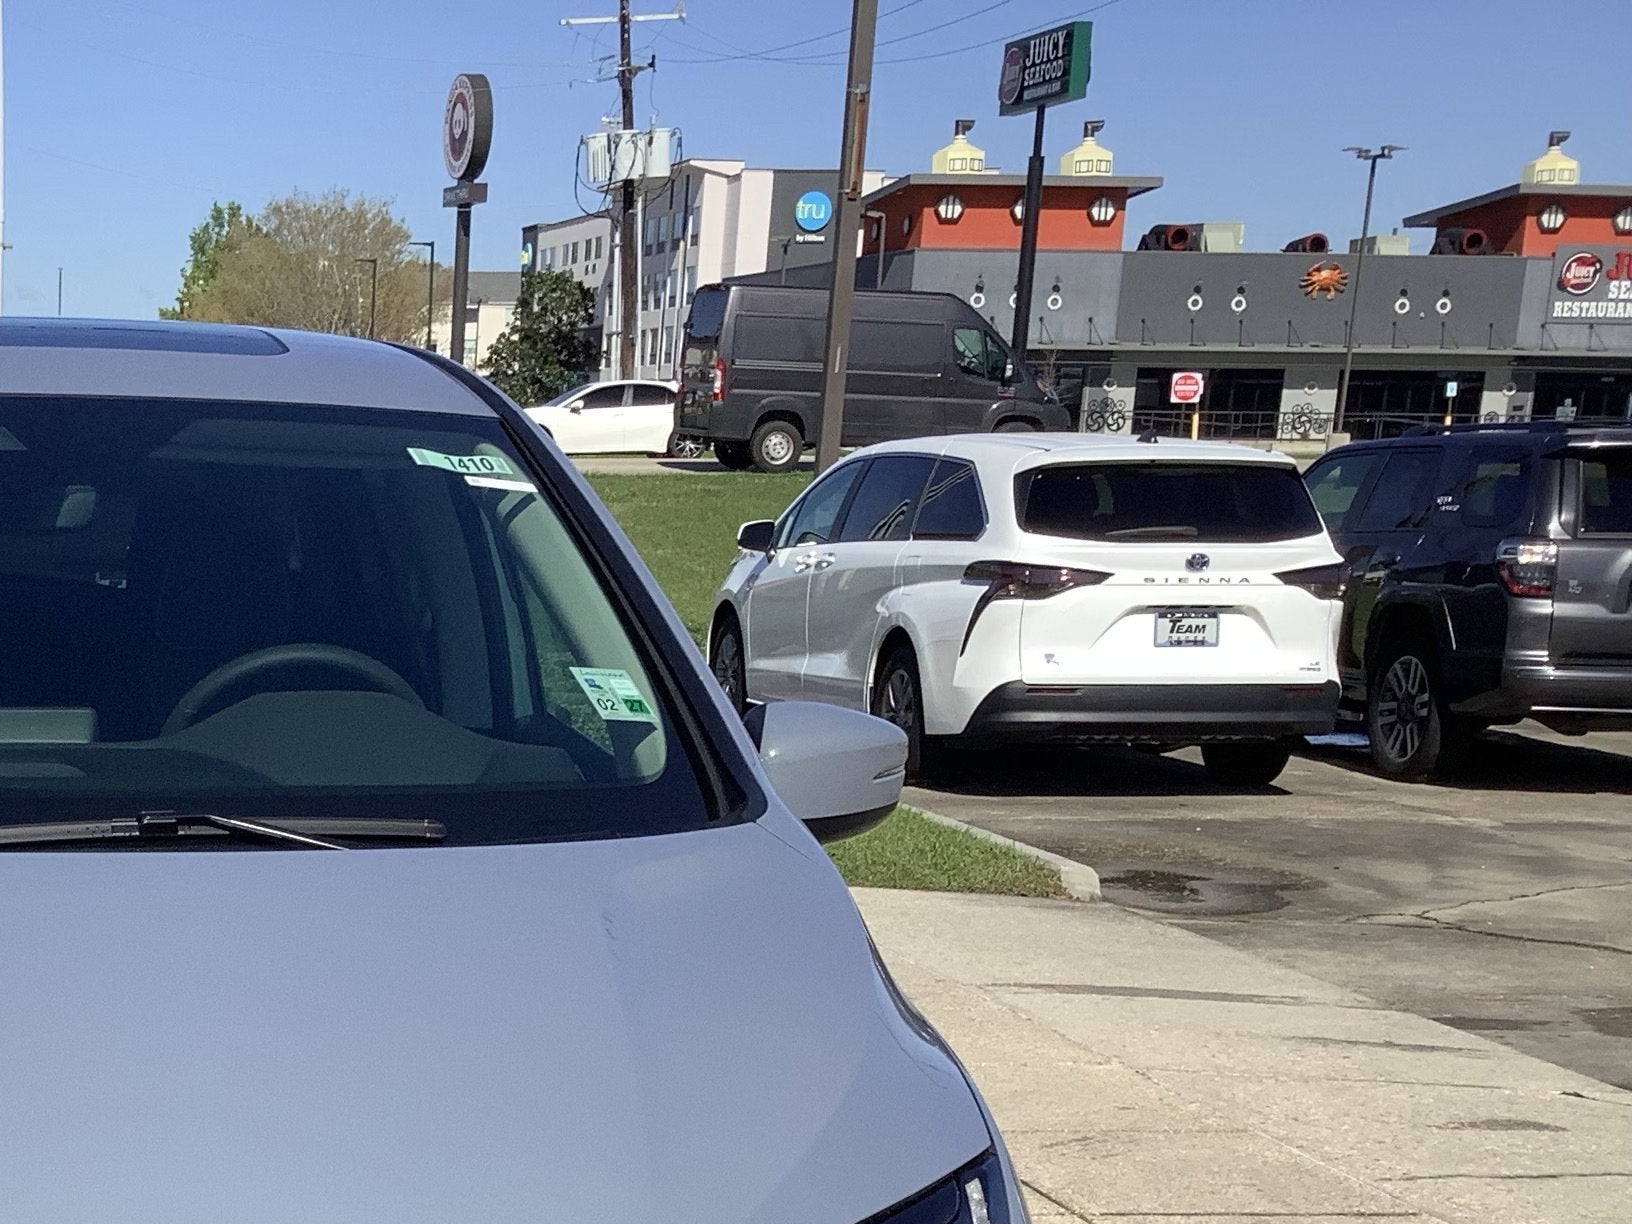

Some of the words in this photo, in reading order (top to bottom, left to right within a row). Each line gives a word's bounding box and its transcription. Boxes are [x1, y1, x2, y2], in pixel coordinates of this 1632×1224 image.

[1025, 30, 1067, 67] JUICY
[1024, 59, 1064, 87] SEAFOOD
[796, 200, 825, 220] tru
[444, 456, 495, 472] 1410
[1168, 618, 1207, 634] TEAM
[597, 698, 619, 711] 02
